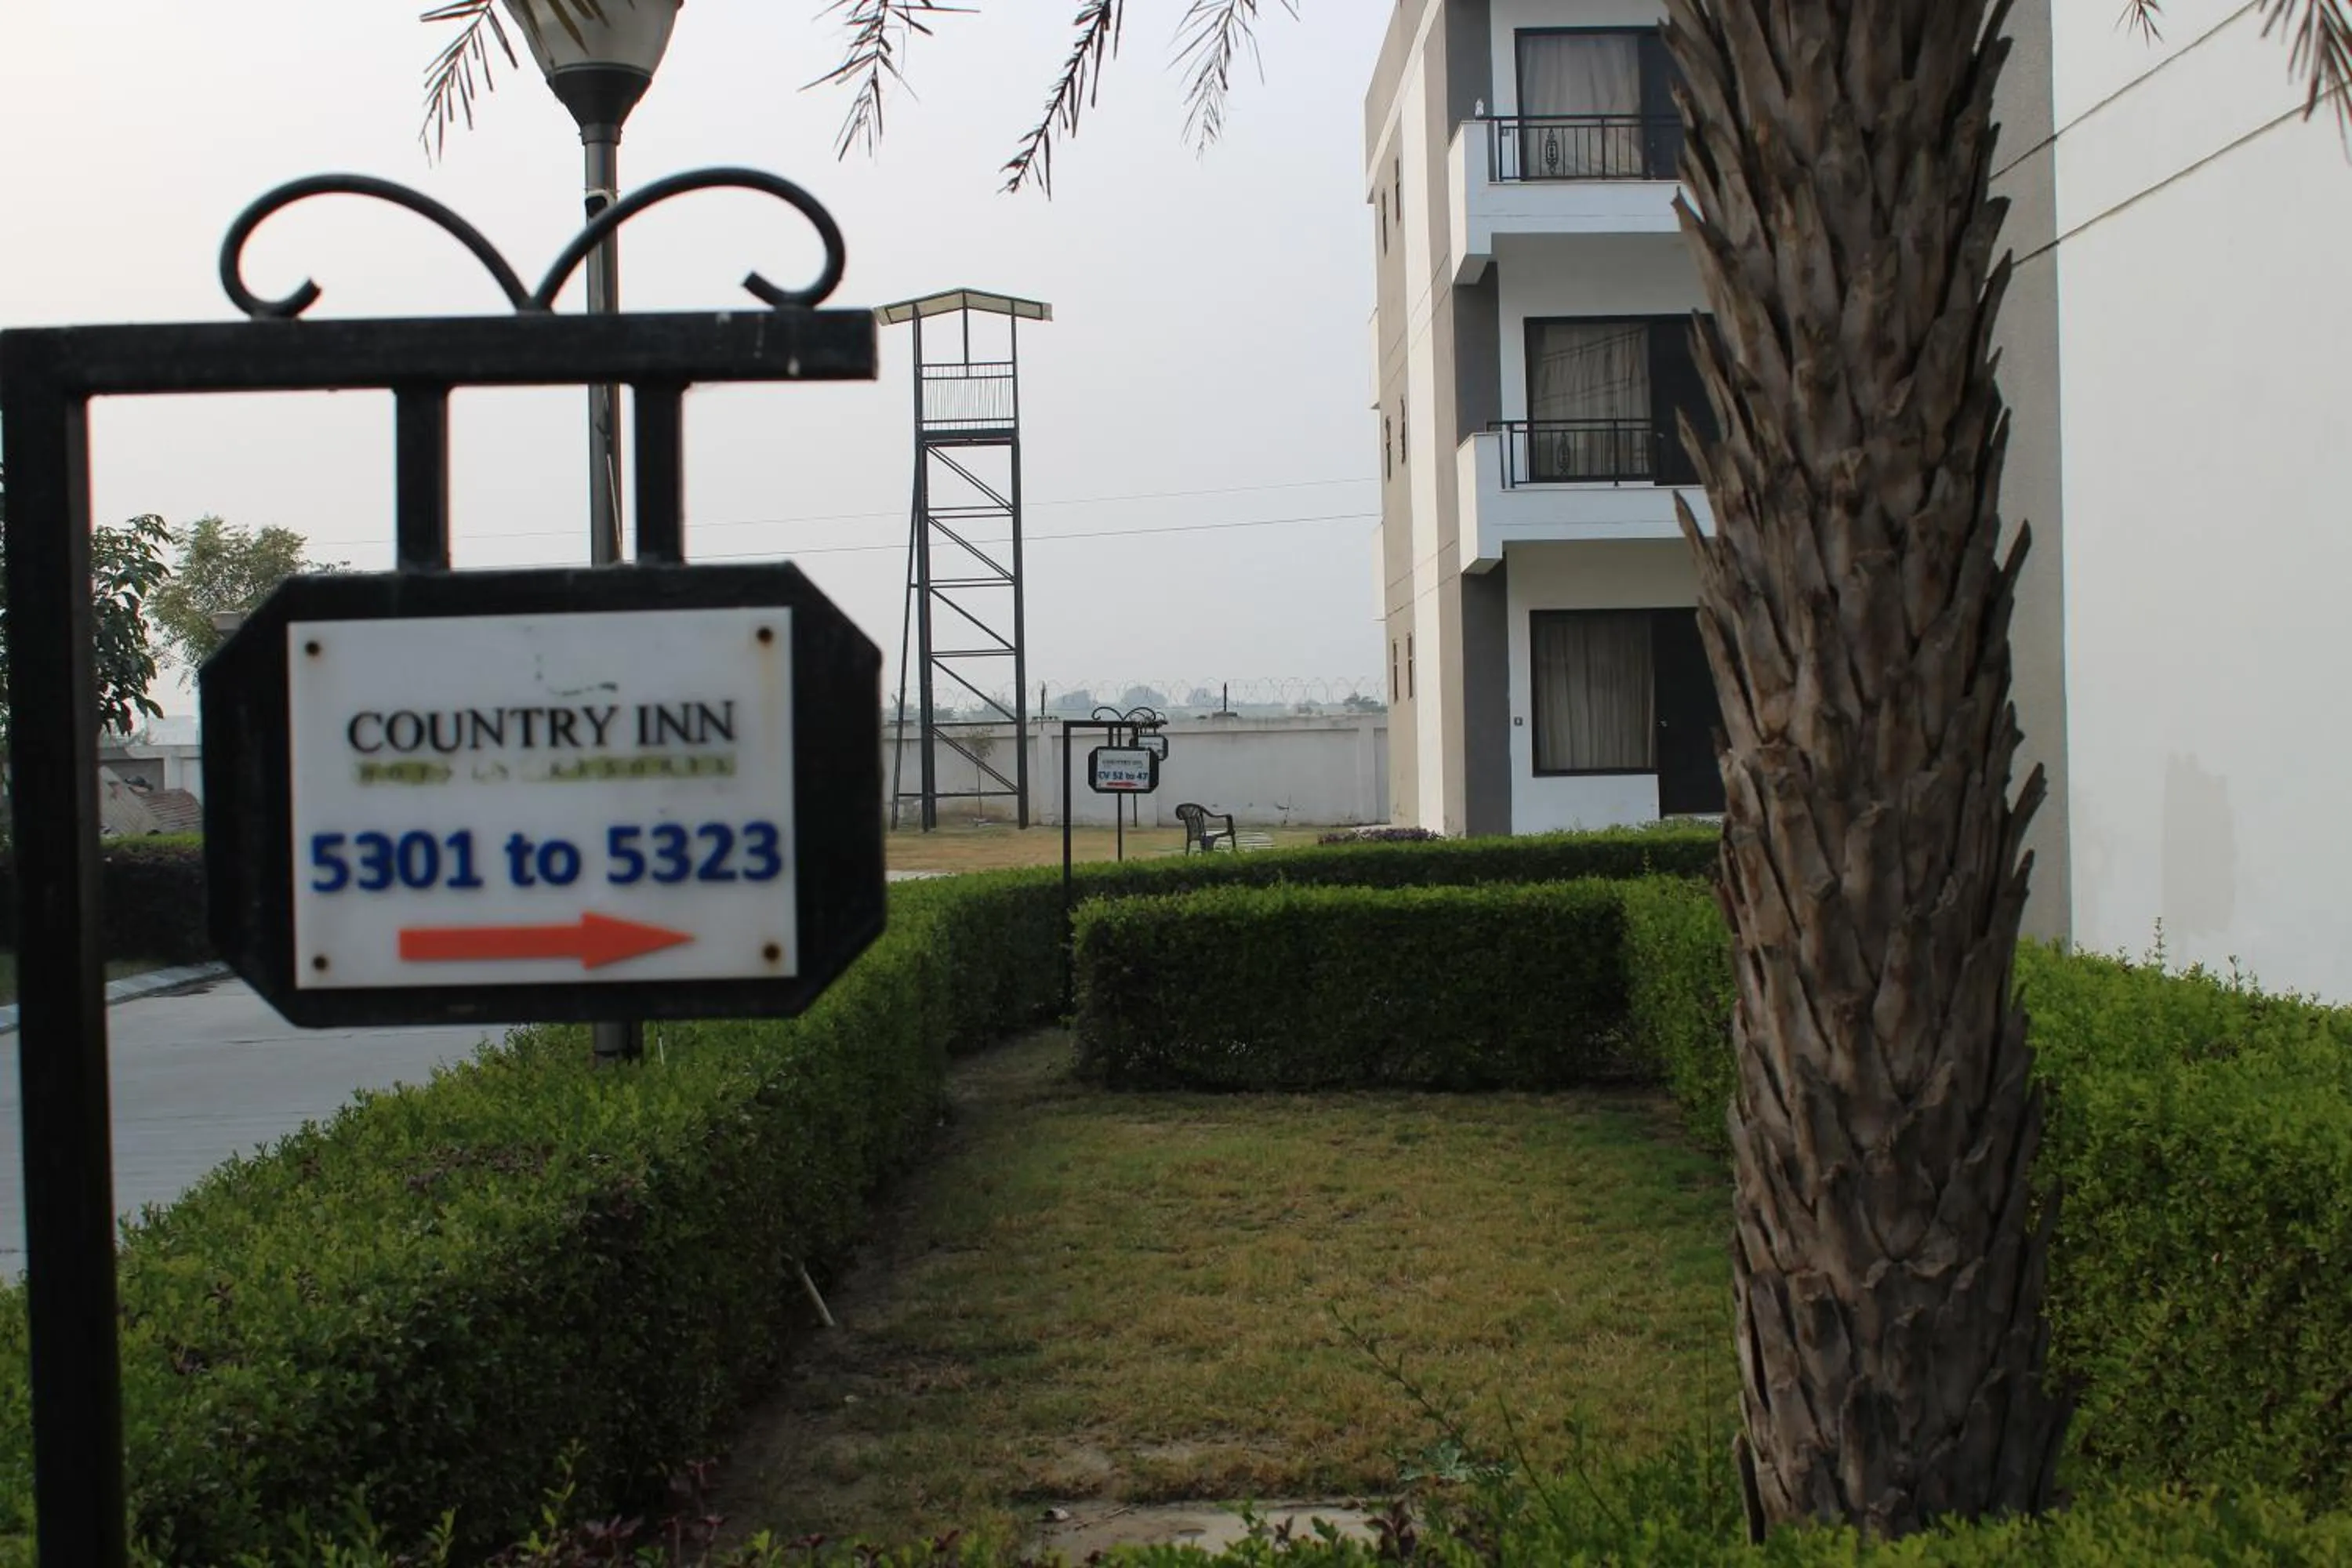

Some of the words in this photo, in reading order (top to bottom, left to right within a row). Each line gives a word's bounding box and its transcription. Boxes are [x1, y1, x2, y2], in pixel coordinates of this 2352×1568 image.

[347, 703, 618, 753] COUNTRY
[636, 700, 735, 746] INN
[310, 829, 483, 893] 5301
[504, 832, 581, 887] to
[606, 820, 782, 884] 5323
